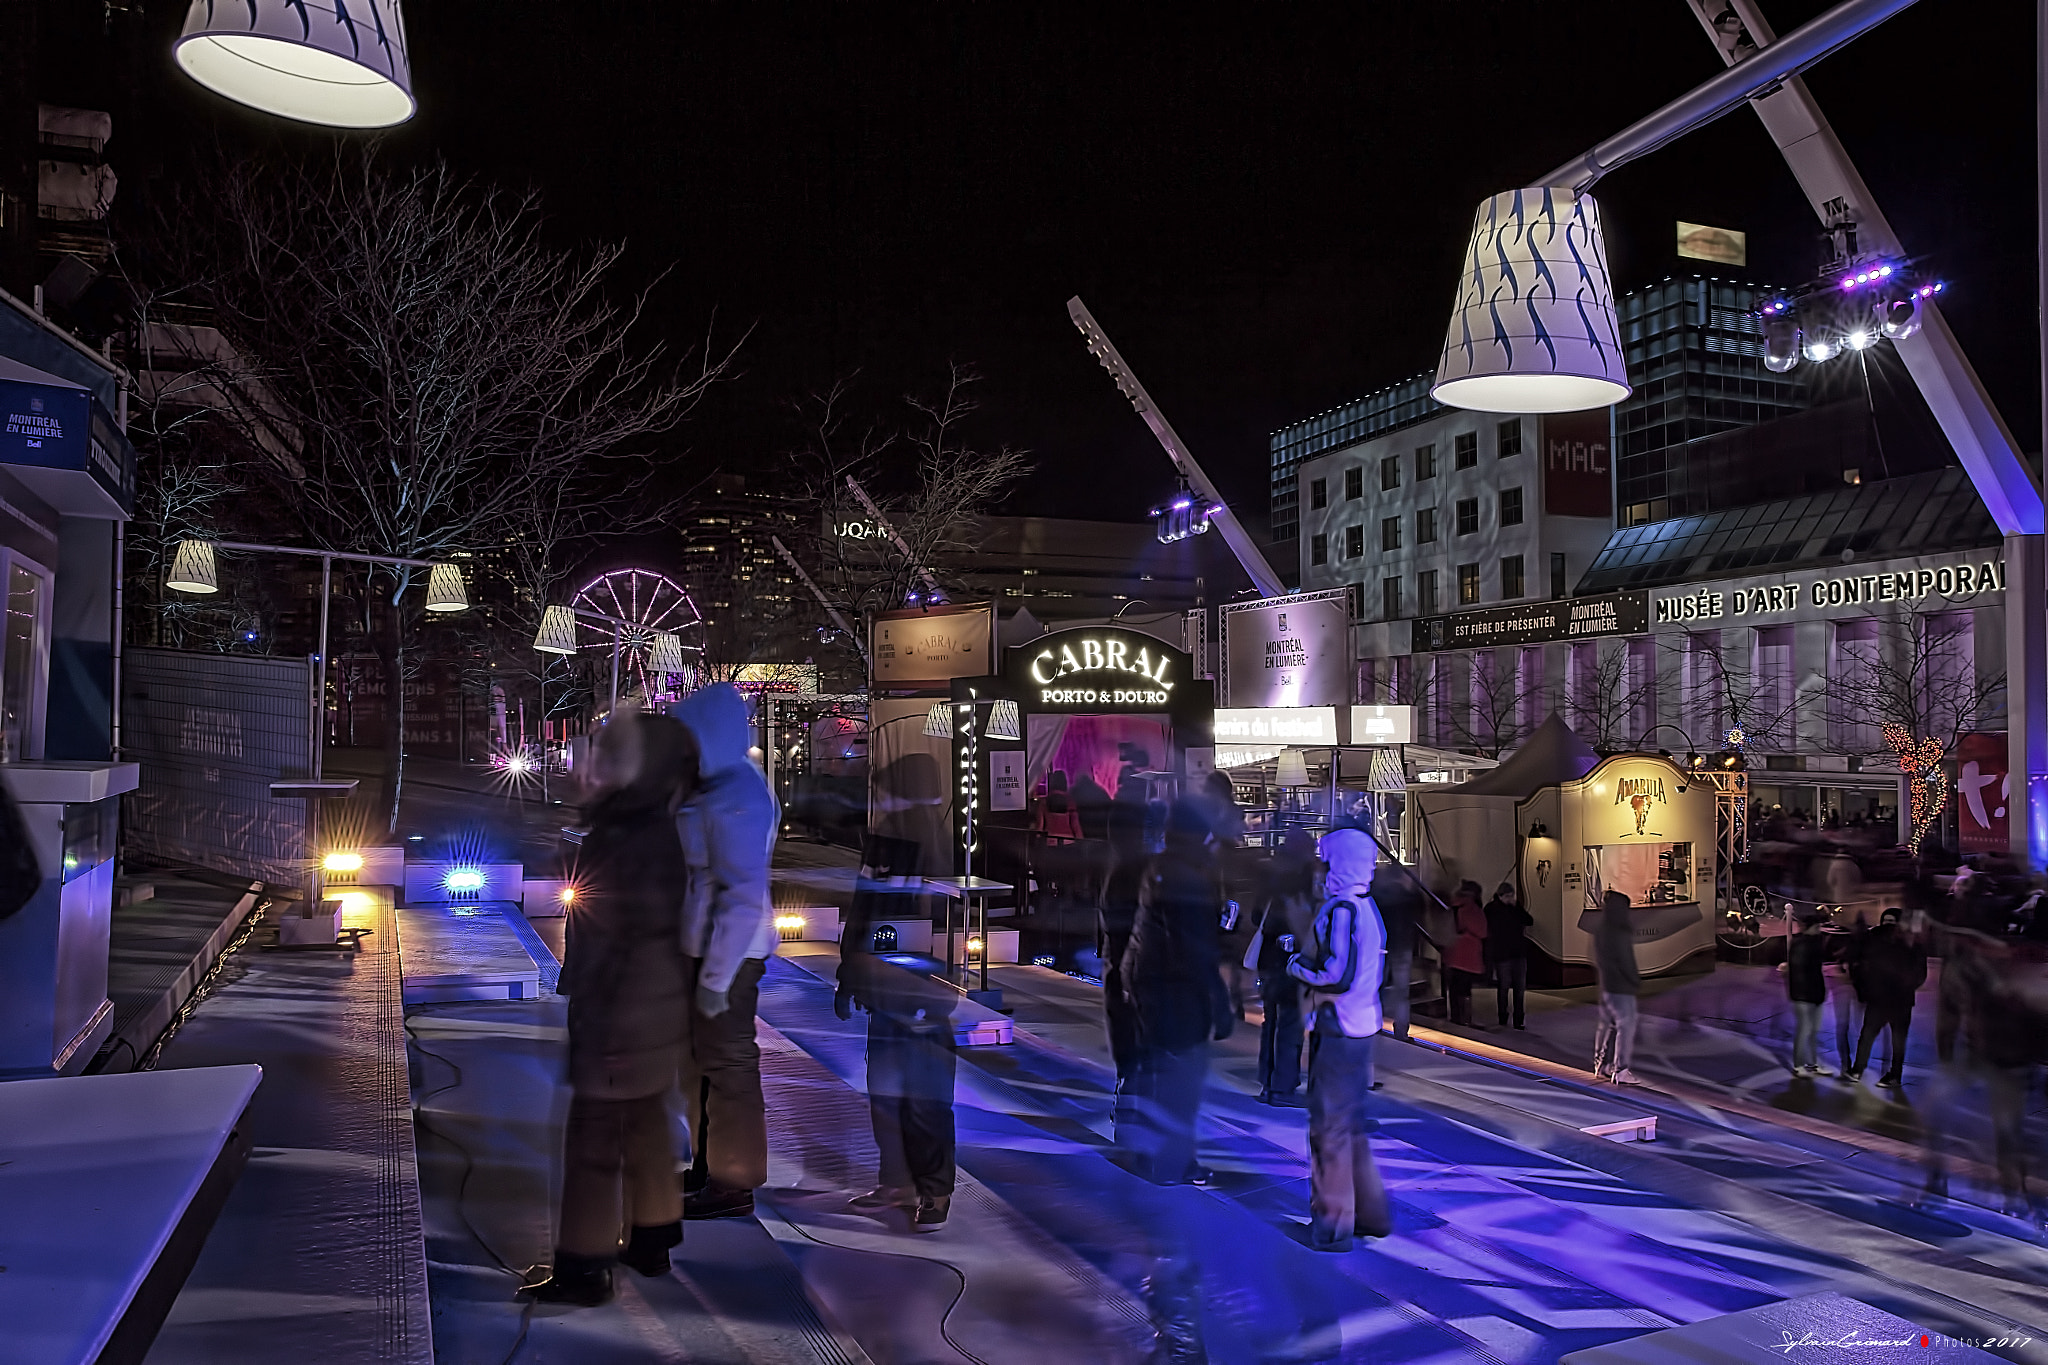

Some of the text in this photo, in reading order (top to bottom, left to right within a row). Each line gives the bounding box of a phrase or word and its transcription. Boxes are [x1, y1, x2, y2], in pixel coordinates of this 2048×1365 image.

[6, 424, 20, 433] EN
[1550, 438, 1606, 474] MAC
[1570, 601, 1616, 620] MONTRÉAL
[1656, 588, 1723, 623] MUSÉE
[1733, 584, 1800, 615] D'ART
[1455, 616, 1556, 637] EST FIÈRE DE PRÉSENTER
[1569, 616, 1618, 635] EN LUMIÈRE
[1265, 637, 1304, 655] MONTRÉAL
[1031, 639, 1175, 691] CABRAL
[1265, 656, 1274, 668] EN
[1041, 690, 1168, 704] PORTO & DOURO
[1251, 717, 1269, 736] du
[1614, 777, 1667, 805] AMARULA
